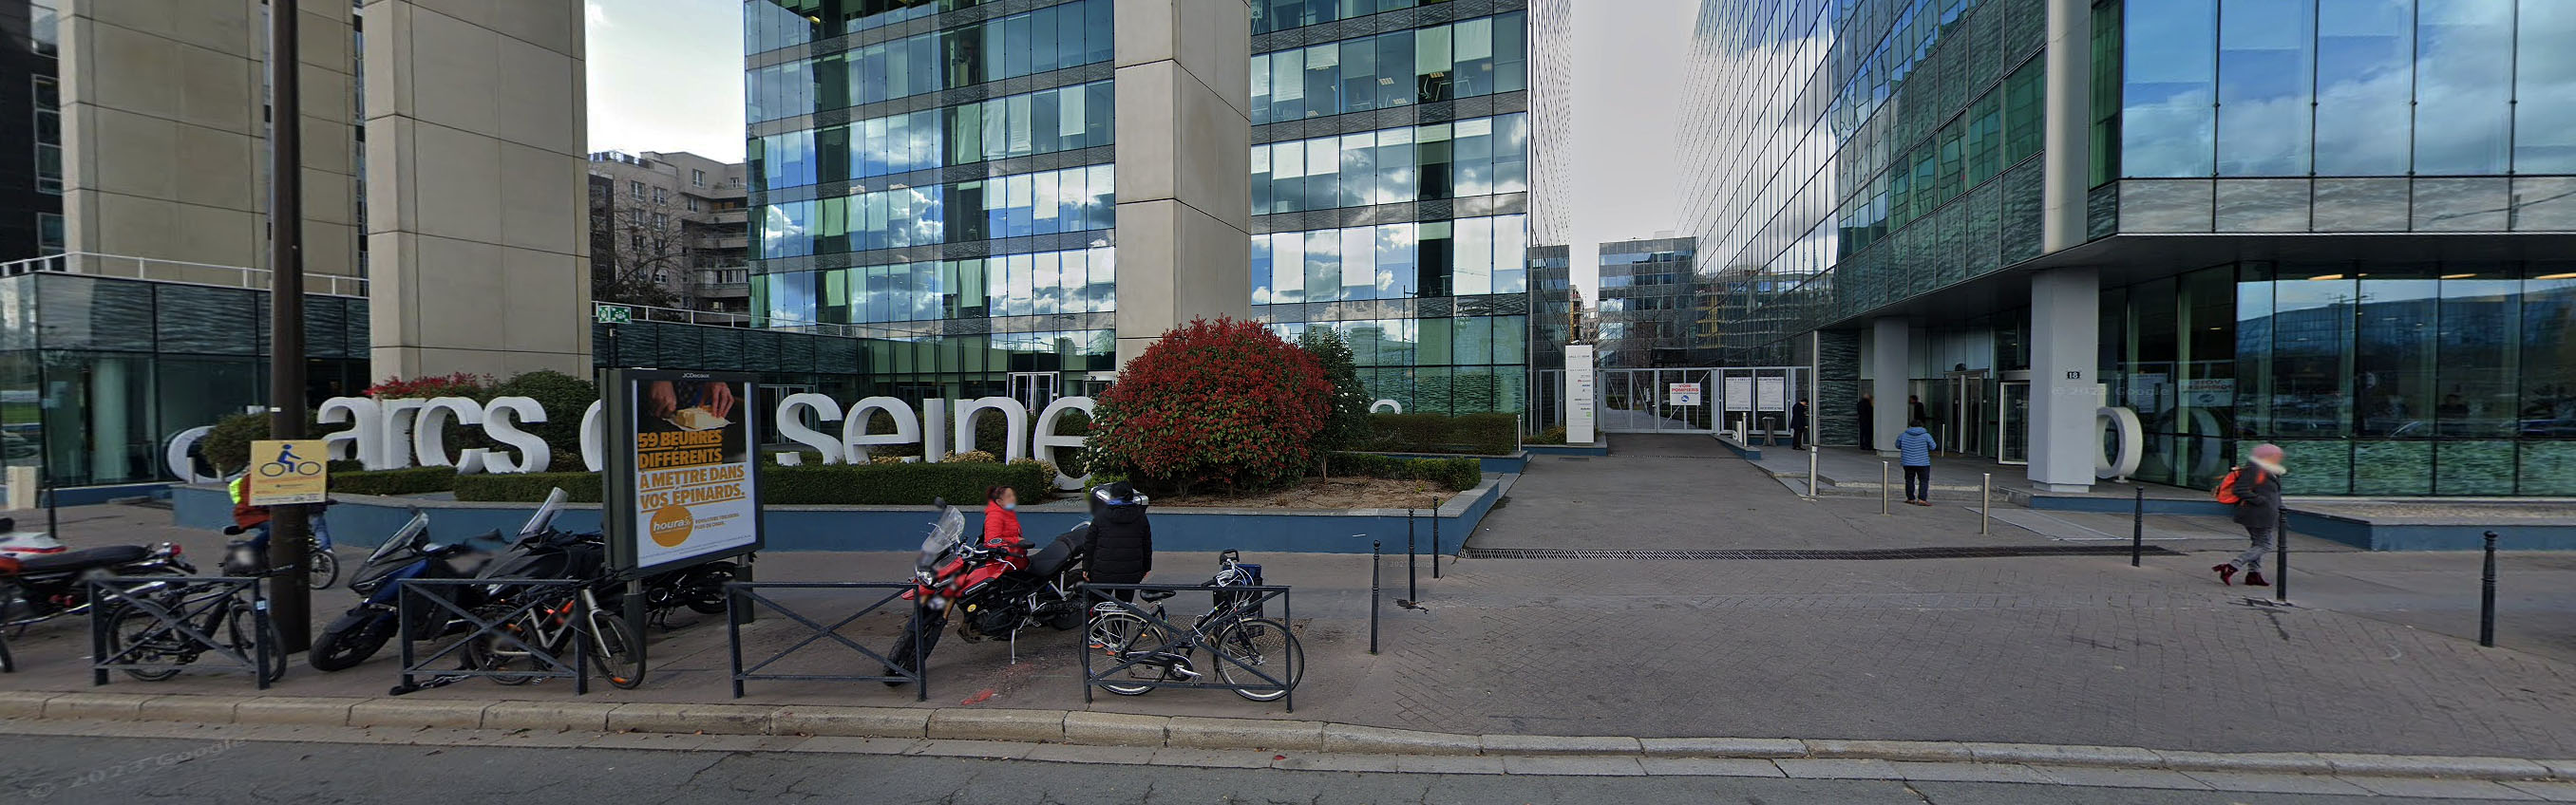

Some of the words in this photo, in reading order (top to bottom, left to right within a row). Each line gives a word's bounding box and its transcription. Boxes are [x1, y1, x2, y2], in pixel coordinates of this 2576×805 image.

[316, 396, 551, 475] arcs
[776, 392, 1098, 491] seine
[637, 433, 659, 448] 59
[660, 429, 723, 447] BEURRES
[638, 446, 723, 469] DIFFÉRENTS
[639, 471, 650, 489] À
[652, 469, 708, 487] METTRE
[710, 464, 745, 481] DANS
[640, 492, 669, 510] VOS
[672, 483, 746, 506] ÉPINARDS.
